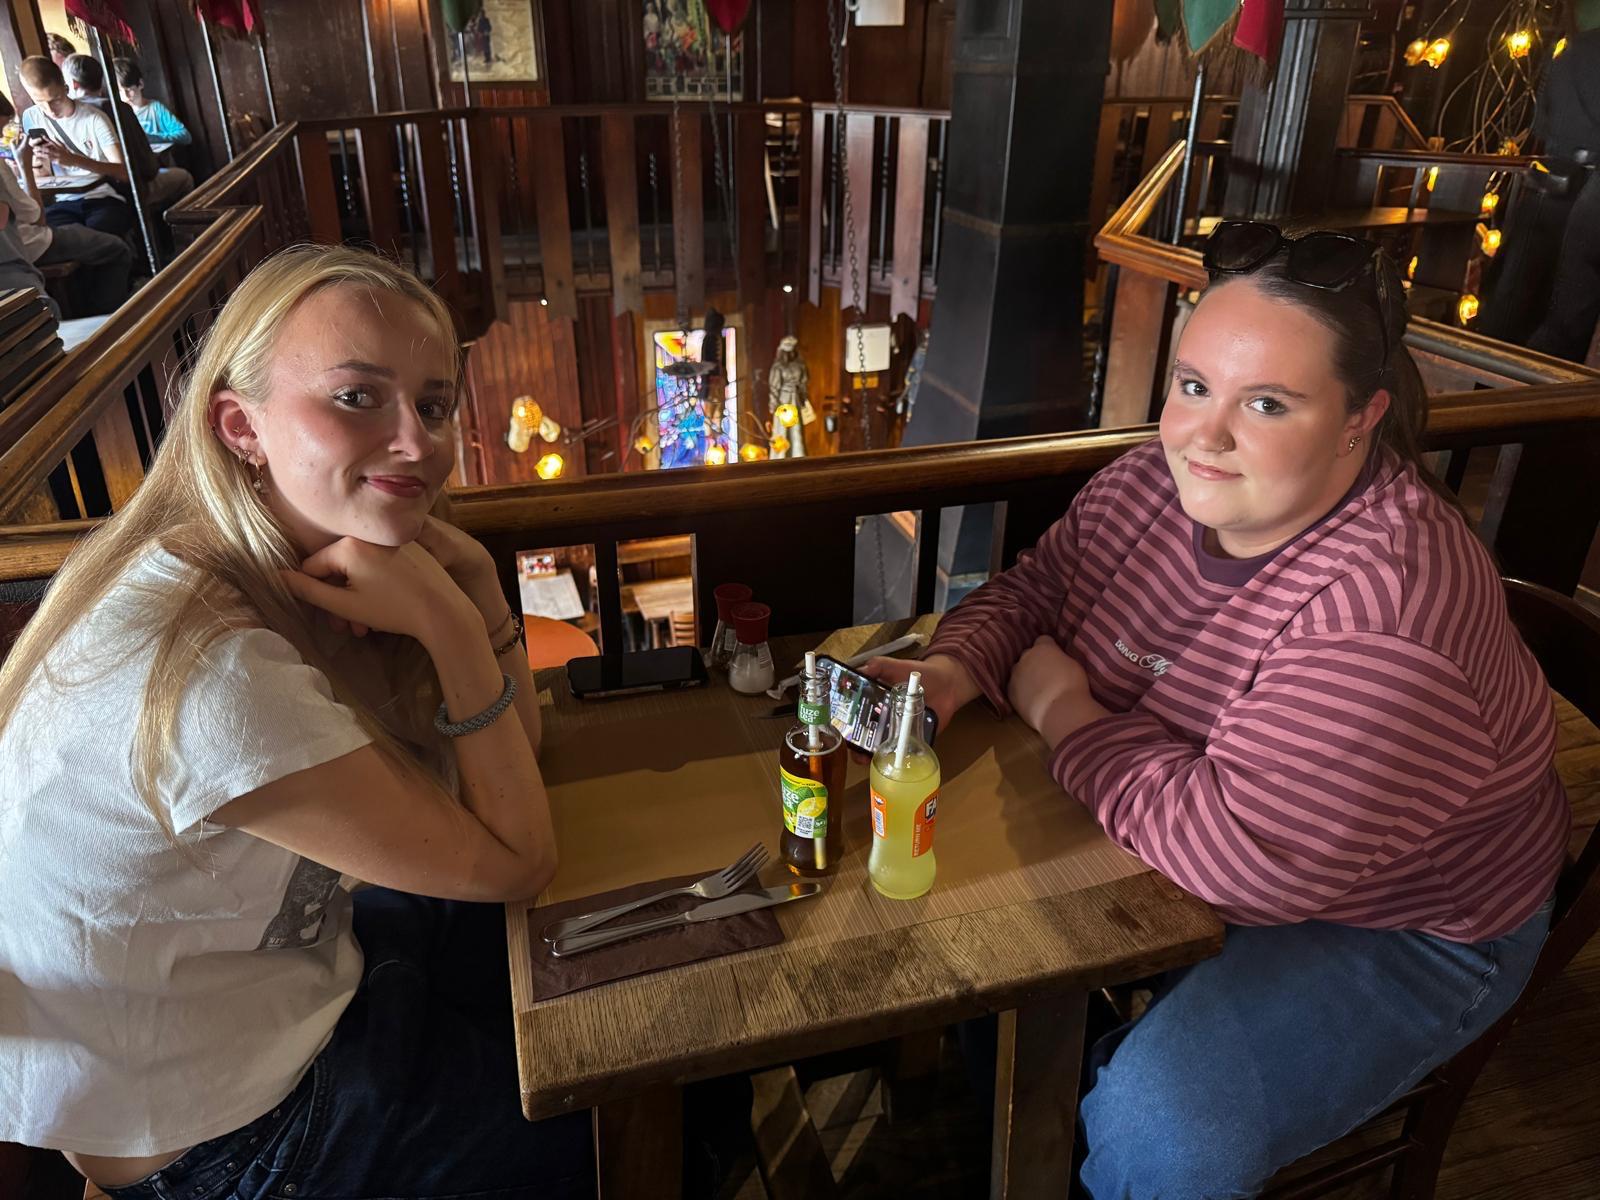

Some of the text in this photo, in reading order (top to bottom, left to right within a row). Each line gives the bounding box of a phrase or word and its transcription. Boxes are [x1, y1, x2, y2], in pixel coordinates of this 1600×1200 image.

[1115, 640, 1139, 662] DOING
[800, 704, 820, 717] fuze
[800, 712, 814, 723] tea
